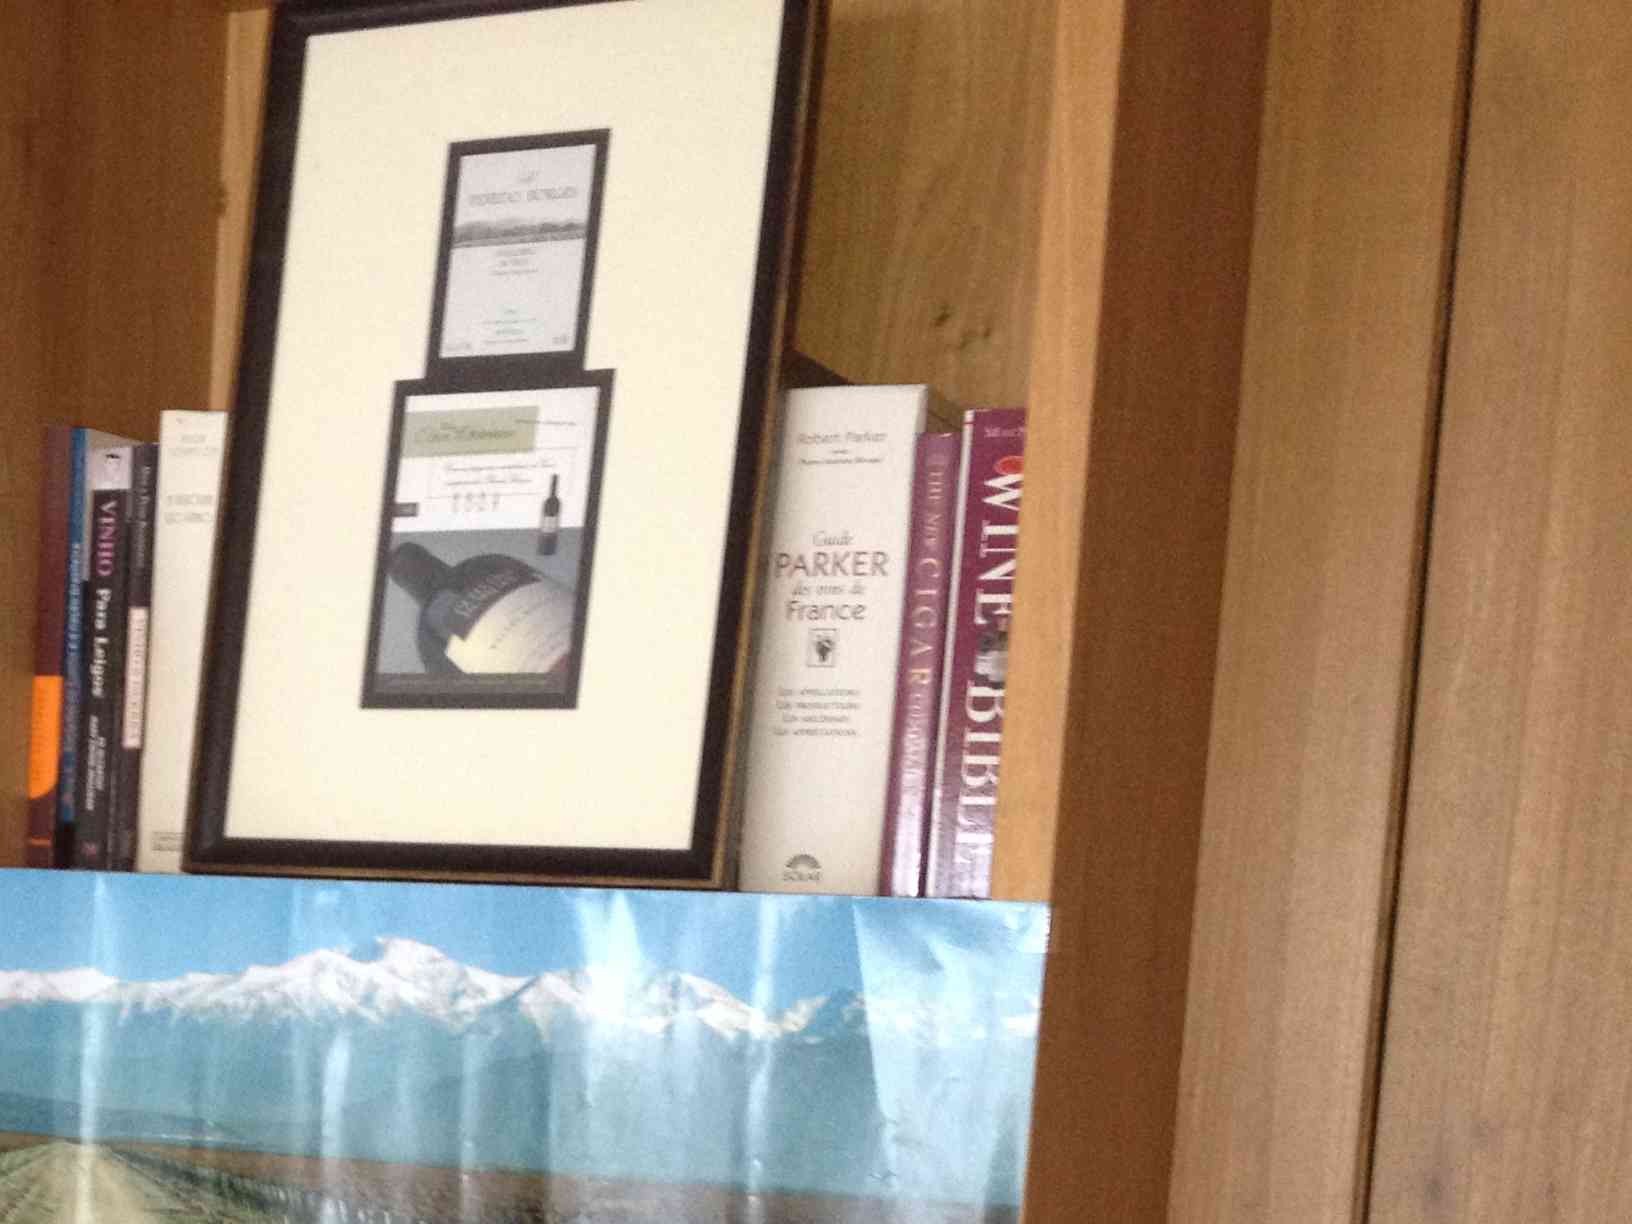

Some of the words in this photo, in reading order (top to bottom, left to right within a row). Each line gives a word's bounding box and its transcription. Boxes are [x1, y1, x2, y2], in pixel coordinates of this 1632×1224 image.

[96, 500, 117, 577] VINHO
[775, 551, 889, 578] PARKER
[973, 472, 1025, 625] WINE
[94, 587, 112, 630] Para
[786, 600, 867, 620] France
[909, 557, 940, 686] CIGAR
[90, 636, 110, 698] Leigos
[955, 680, 1006, 864] BIBLE
